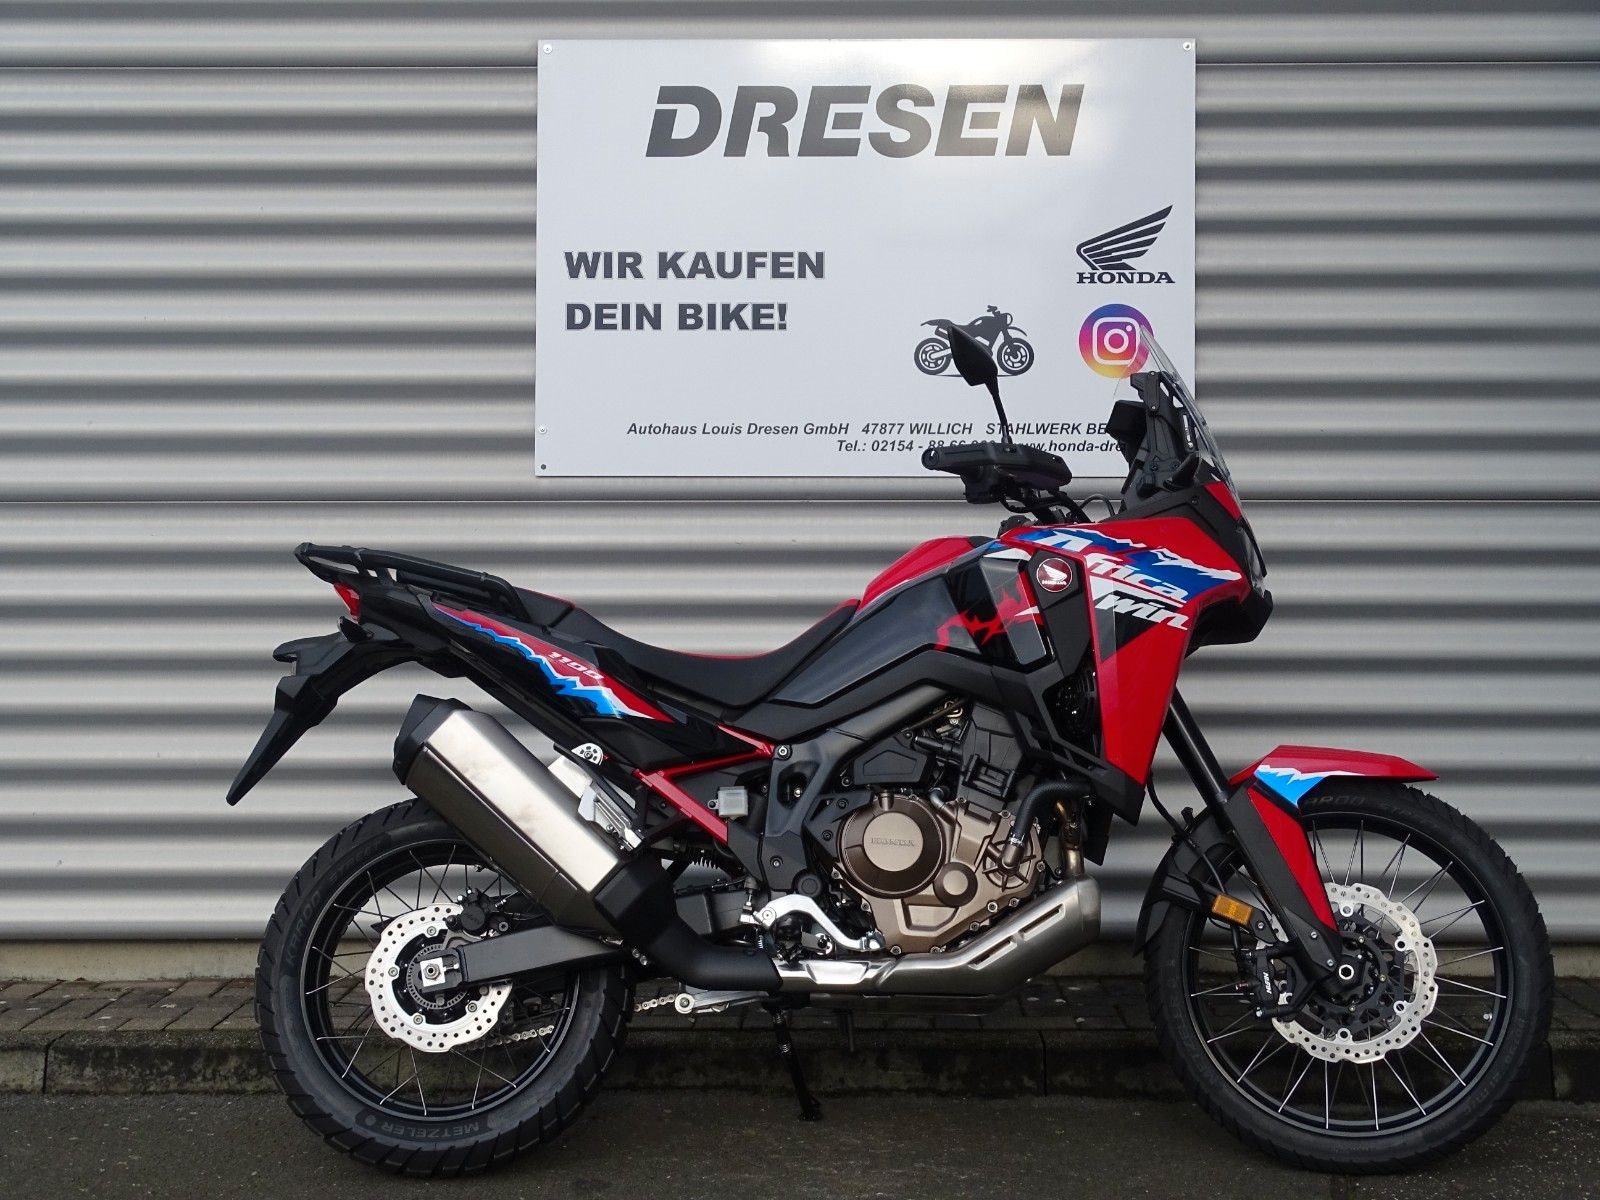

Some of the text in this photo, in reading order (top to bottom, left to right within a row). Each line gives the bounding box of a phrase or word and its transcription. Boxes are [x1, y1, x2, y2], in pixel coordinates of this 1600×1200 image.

[645, 84, 1084, 158] DRESEN
[564, 251, 825, 279] WIR KAUFEN
[1076, 272, 1176, 284] HONDA
[566, 303, 787, 331] DEIN BIKE!
[627, 423, 697, 435] Autohaus
[702, 423, 743, 435] Louis
[747, 423, 799, 435] Dresen
[803, 423, 849, 435] GmbH
[862, 423, 905, 435] 47877
[909, 423, 973, 435] WILLICH
[1086, 423, 1108, 435] BE
[838, 440, 867, 452] Tel.:
[871, 440, 914, 452] 02154
[548, 651, 605, 680] 1100
[380, 1120, 481, 1138] METZELER
